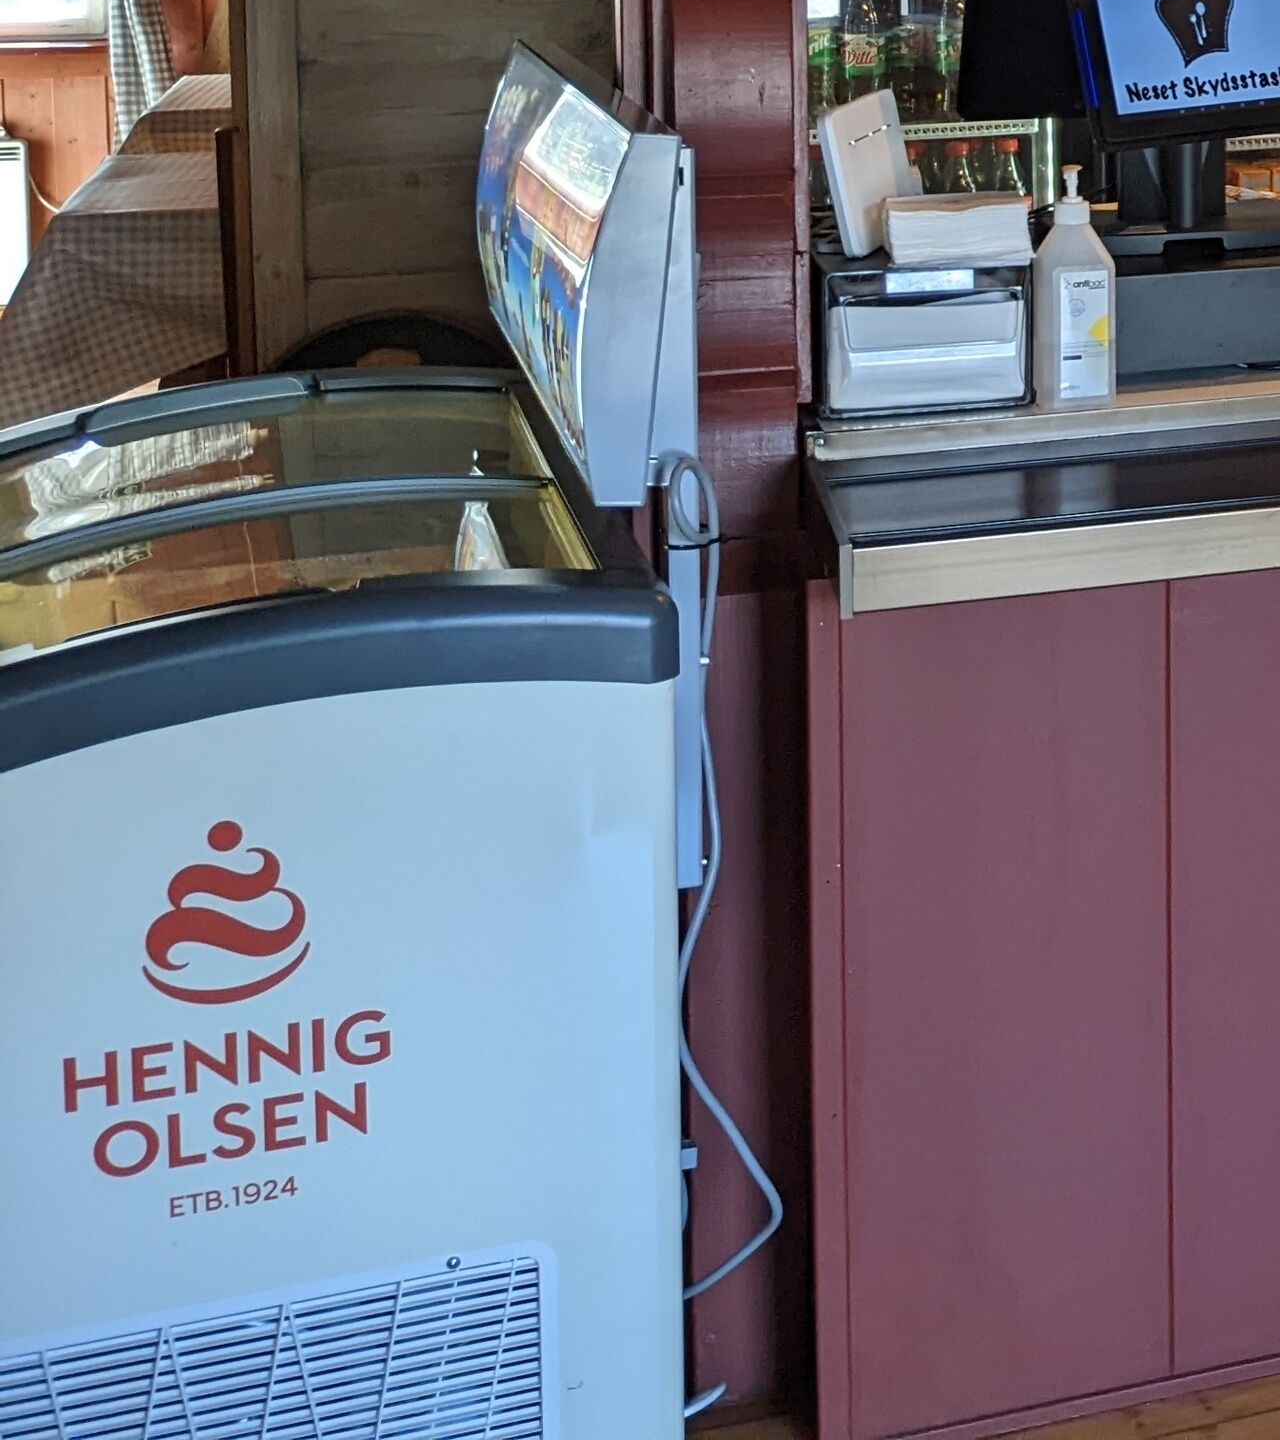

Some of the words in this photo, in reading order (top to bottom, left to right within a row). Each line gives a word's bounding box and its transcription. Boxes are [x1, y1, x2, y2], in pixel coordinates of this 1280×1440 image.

[1125, 80, 1178, 104] Neset
[62, 1010, 392, 1114] HENNIG
[93, 1081, 369, 1178] OLSEN
[169, 1175, 299, 1218] ETB.1924
